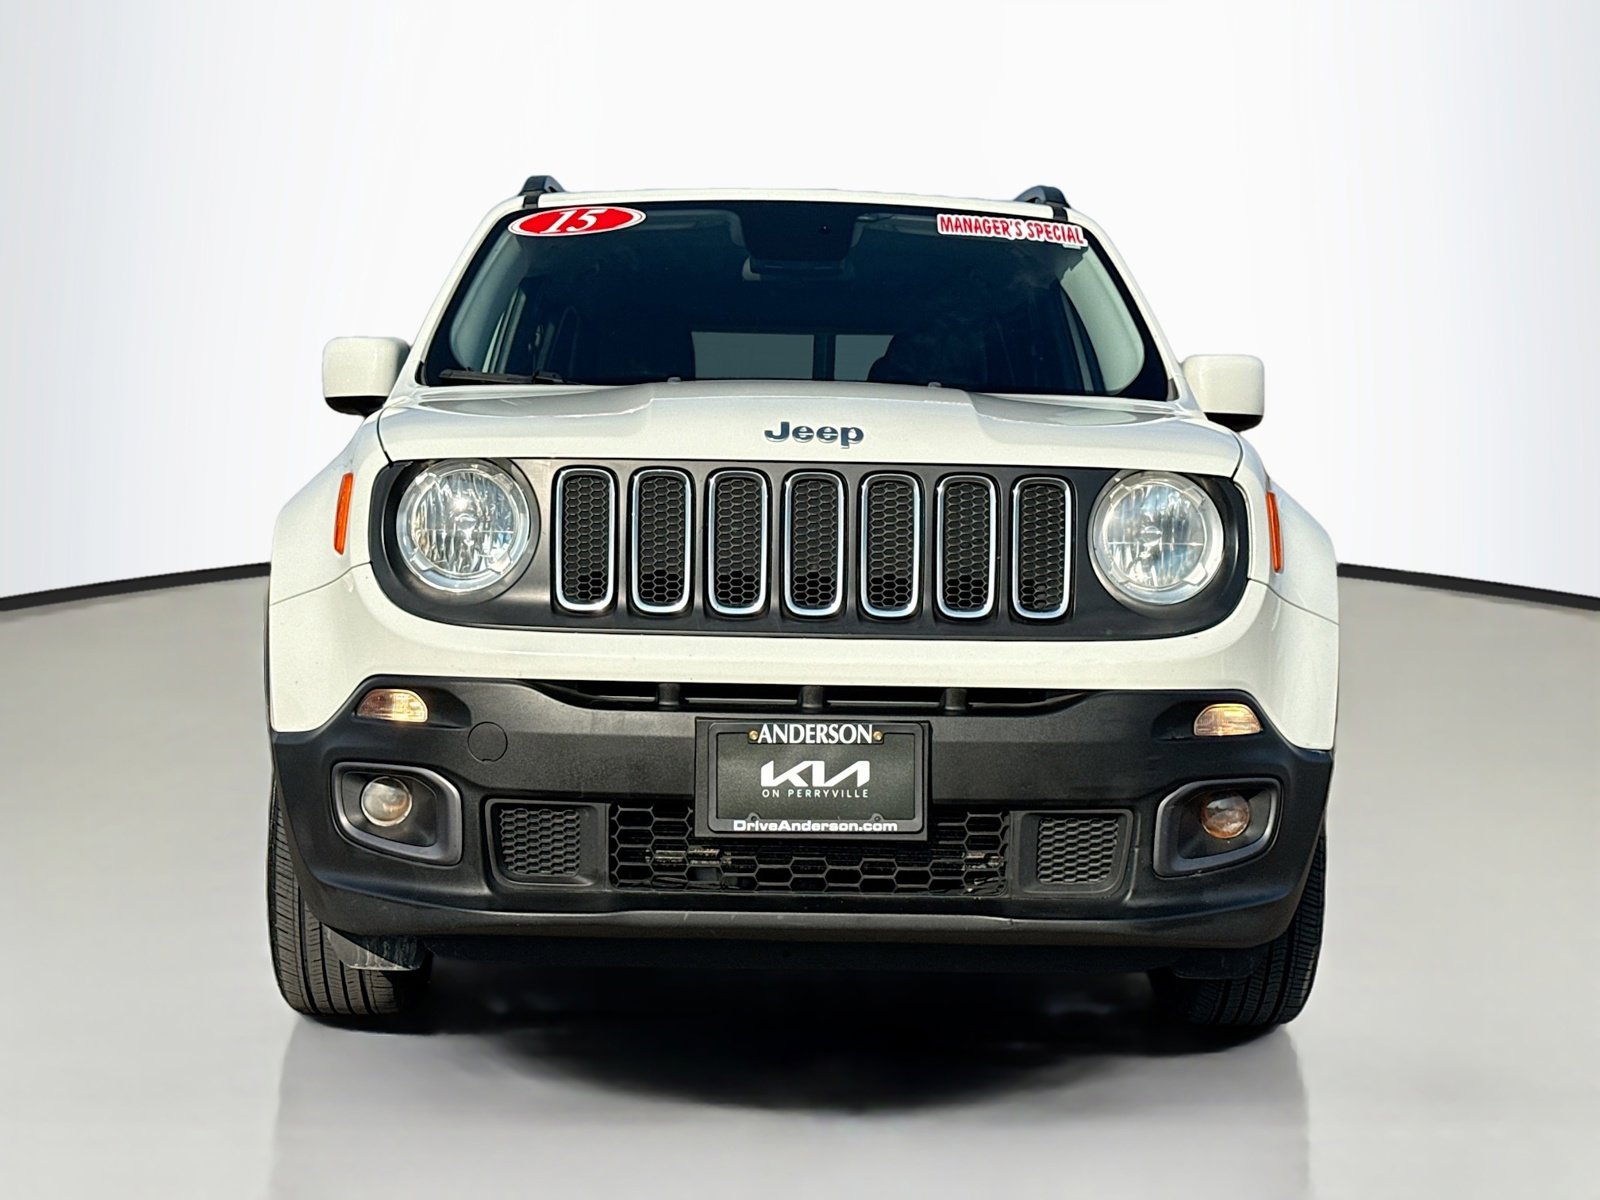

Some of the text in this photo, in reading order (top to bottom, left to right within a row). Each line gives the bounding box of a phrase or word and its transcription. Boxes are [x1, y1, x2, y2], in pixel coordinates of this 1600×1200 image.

[540, 208, 609, 234] 15
[940, 215, 1085, 245] MANAGER'S SPECIAL
[764, 421, 864, 449] Jeep
[757, 723, 873, 744] ANDERSON
[762, 788, 869, 798] ON PERRYVILLE
[733, 819, 898, 832] DriveAnderson.com
